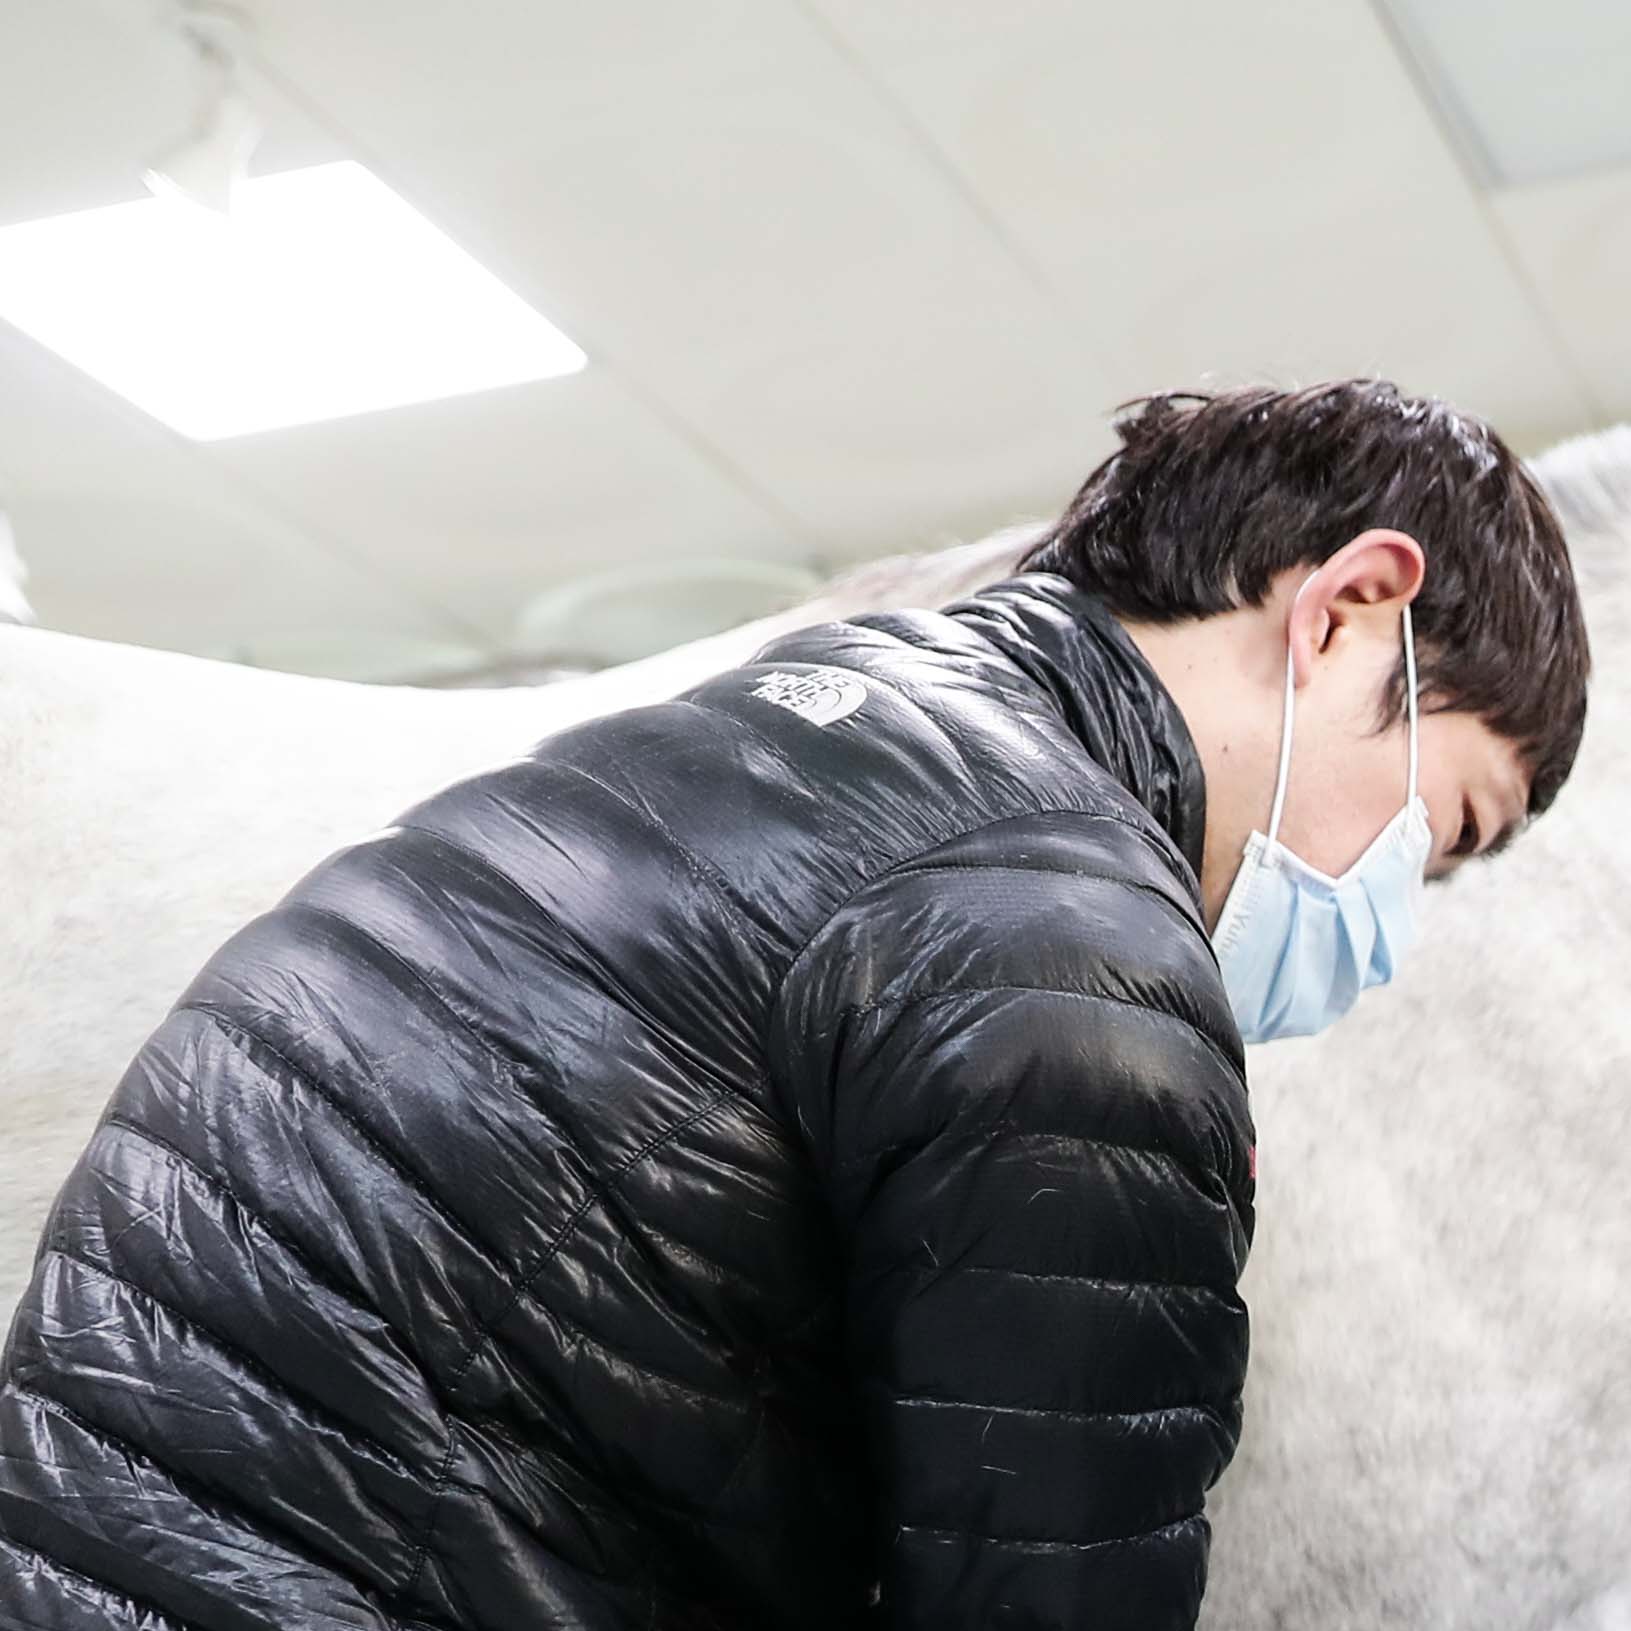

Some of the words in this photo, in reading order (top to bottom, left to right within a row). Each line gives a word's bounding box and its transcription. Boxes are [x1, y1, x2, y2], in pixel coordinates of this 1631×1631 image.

[755, 671, 825, 700] NORTH
[804, 668, 851, 689] THE
[751, 683, 812, 711] FACE
